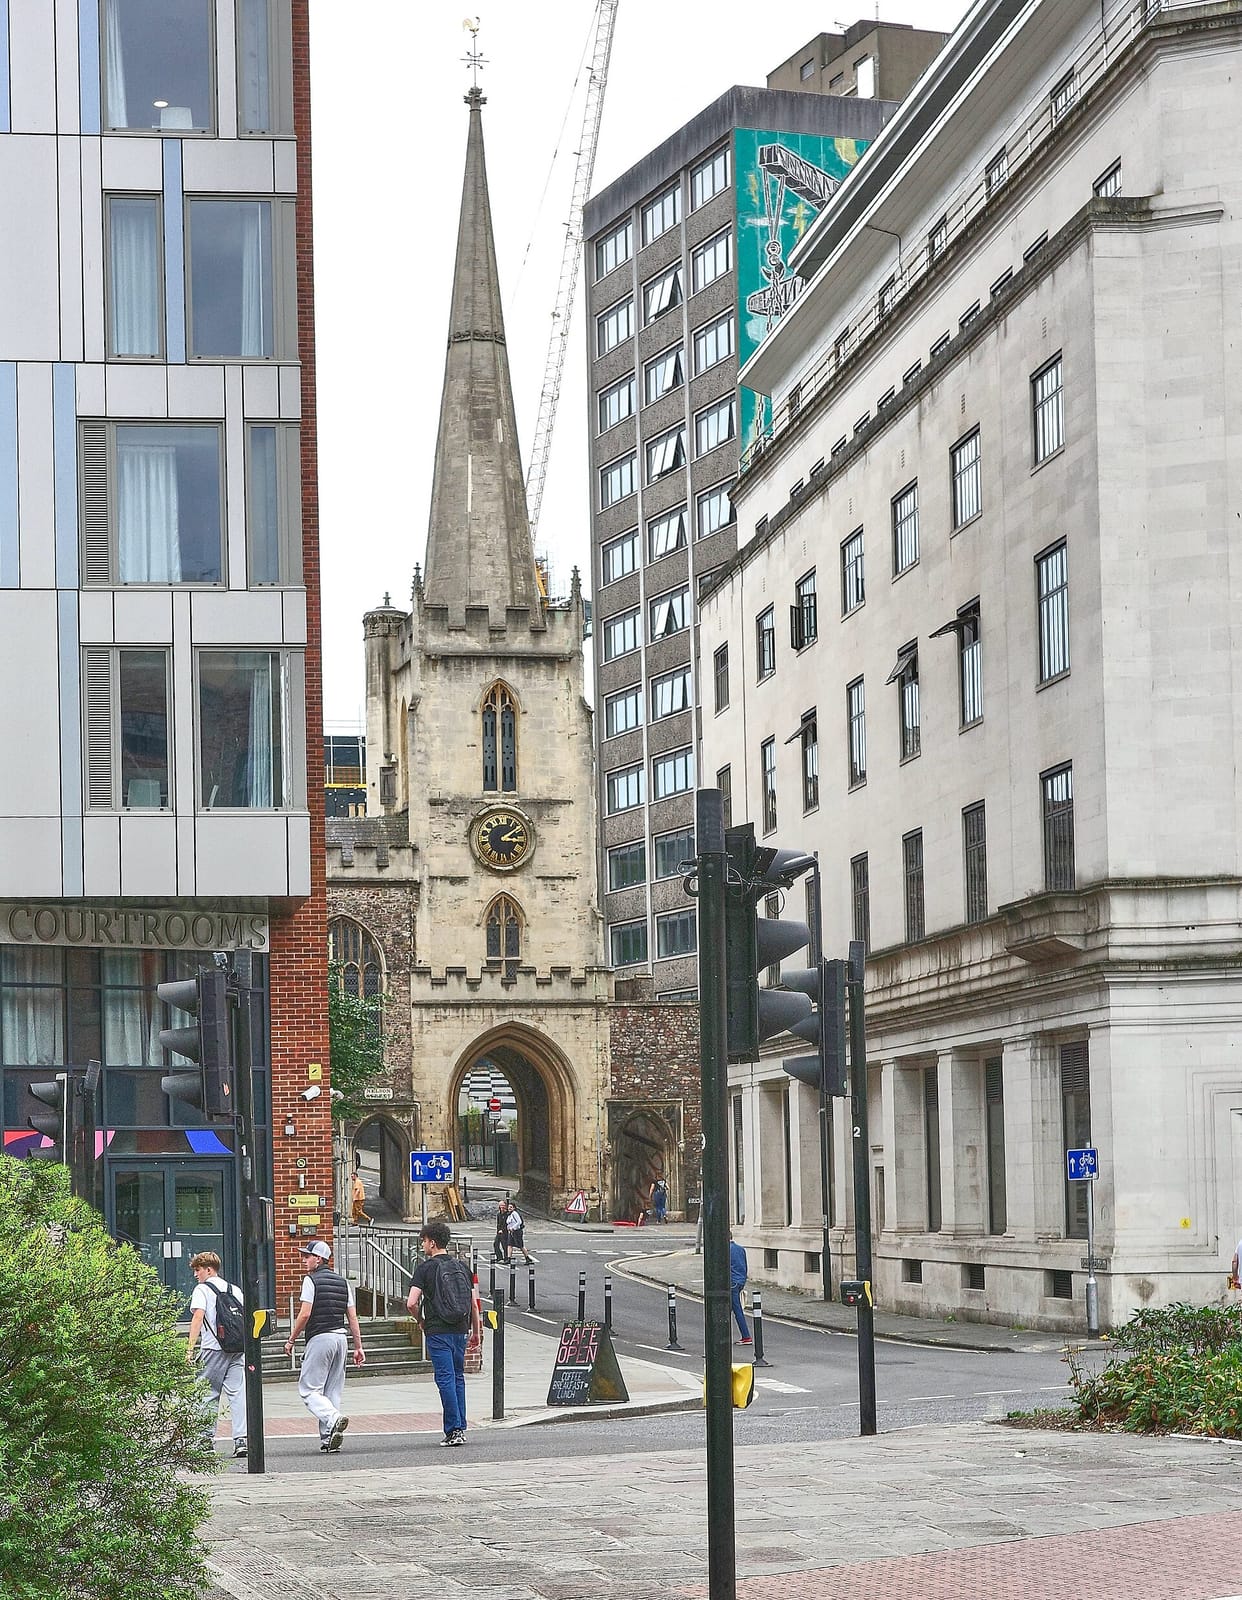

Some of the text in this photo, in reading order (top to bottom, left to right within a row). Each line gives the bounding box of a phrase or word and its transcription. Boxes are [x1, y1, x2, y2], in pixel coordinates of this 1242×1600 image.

[8, 905, 267, 949] COURTROOMS
[853, 1126, 861, 1138] 2
[241, 1144, 247, 1156] 1
[561, 1327, 601, 1345] CAFE
[557, 1346, 598, 1363] OPEN
[556, 1390, 576, 1399] LUNCH
